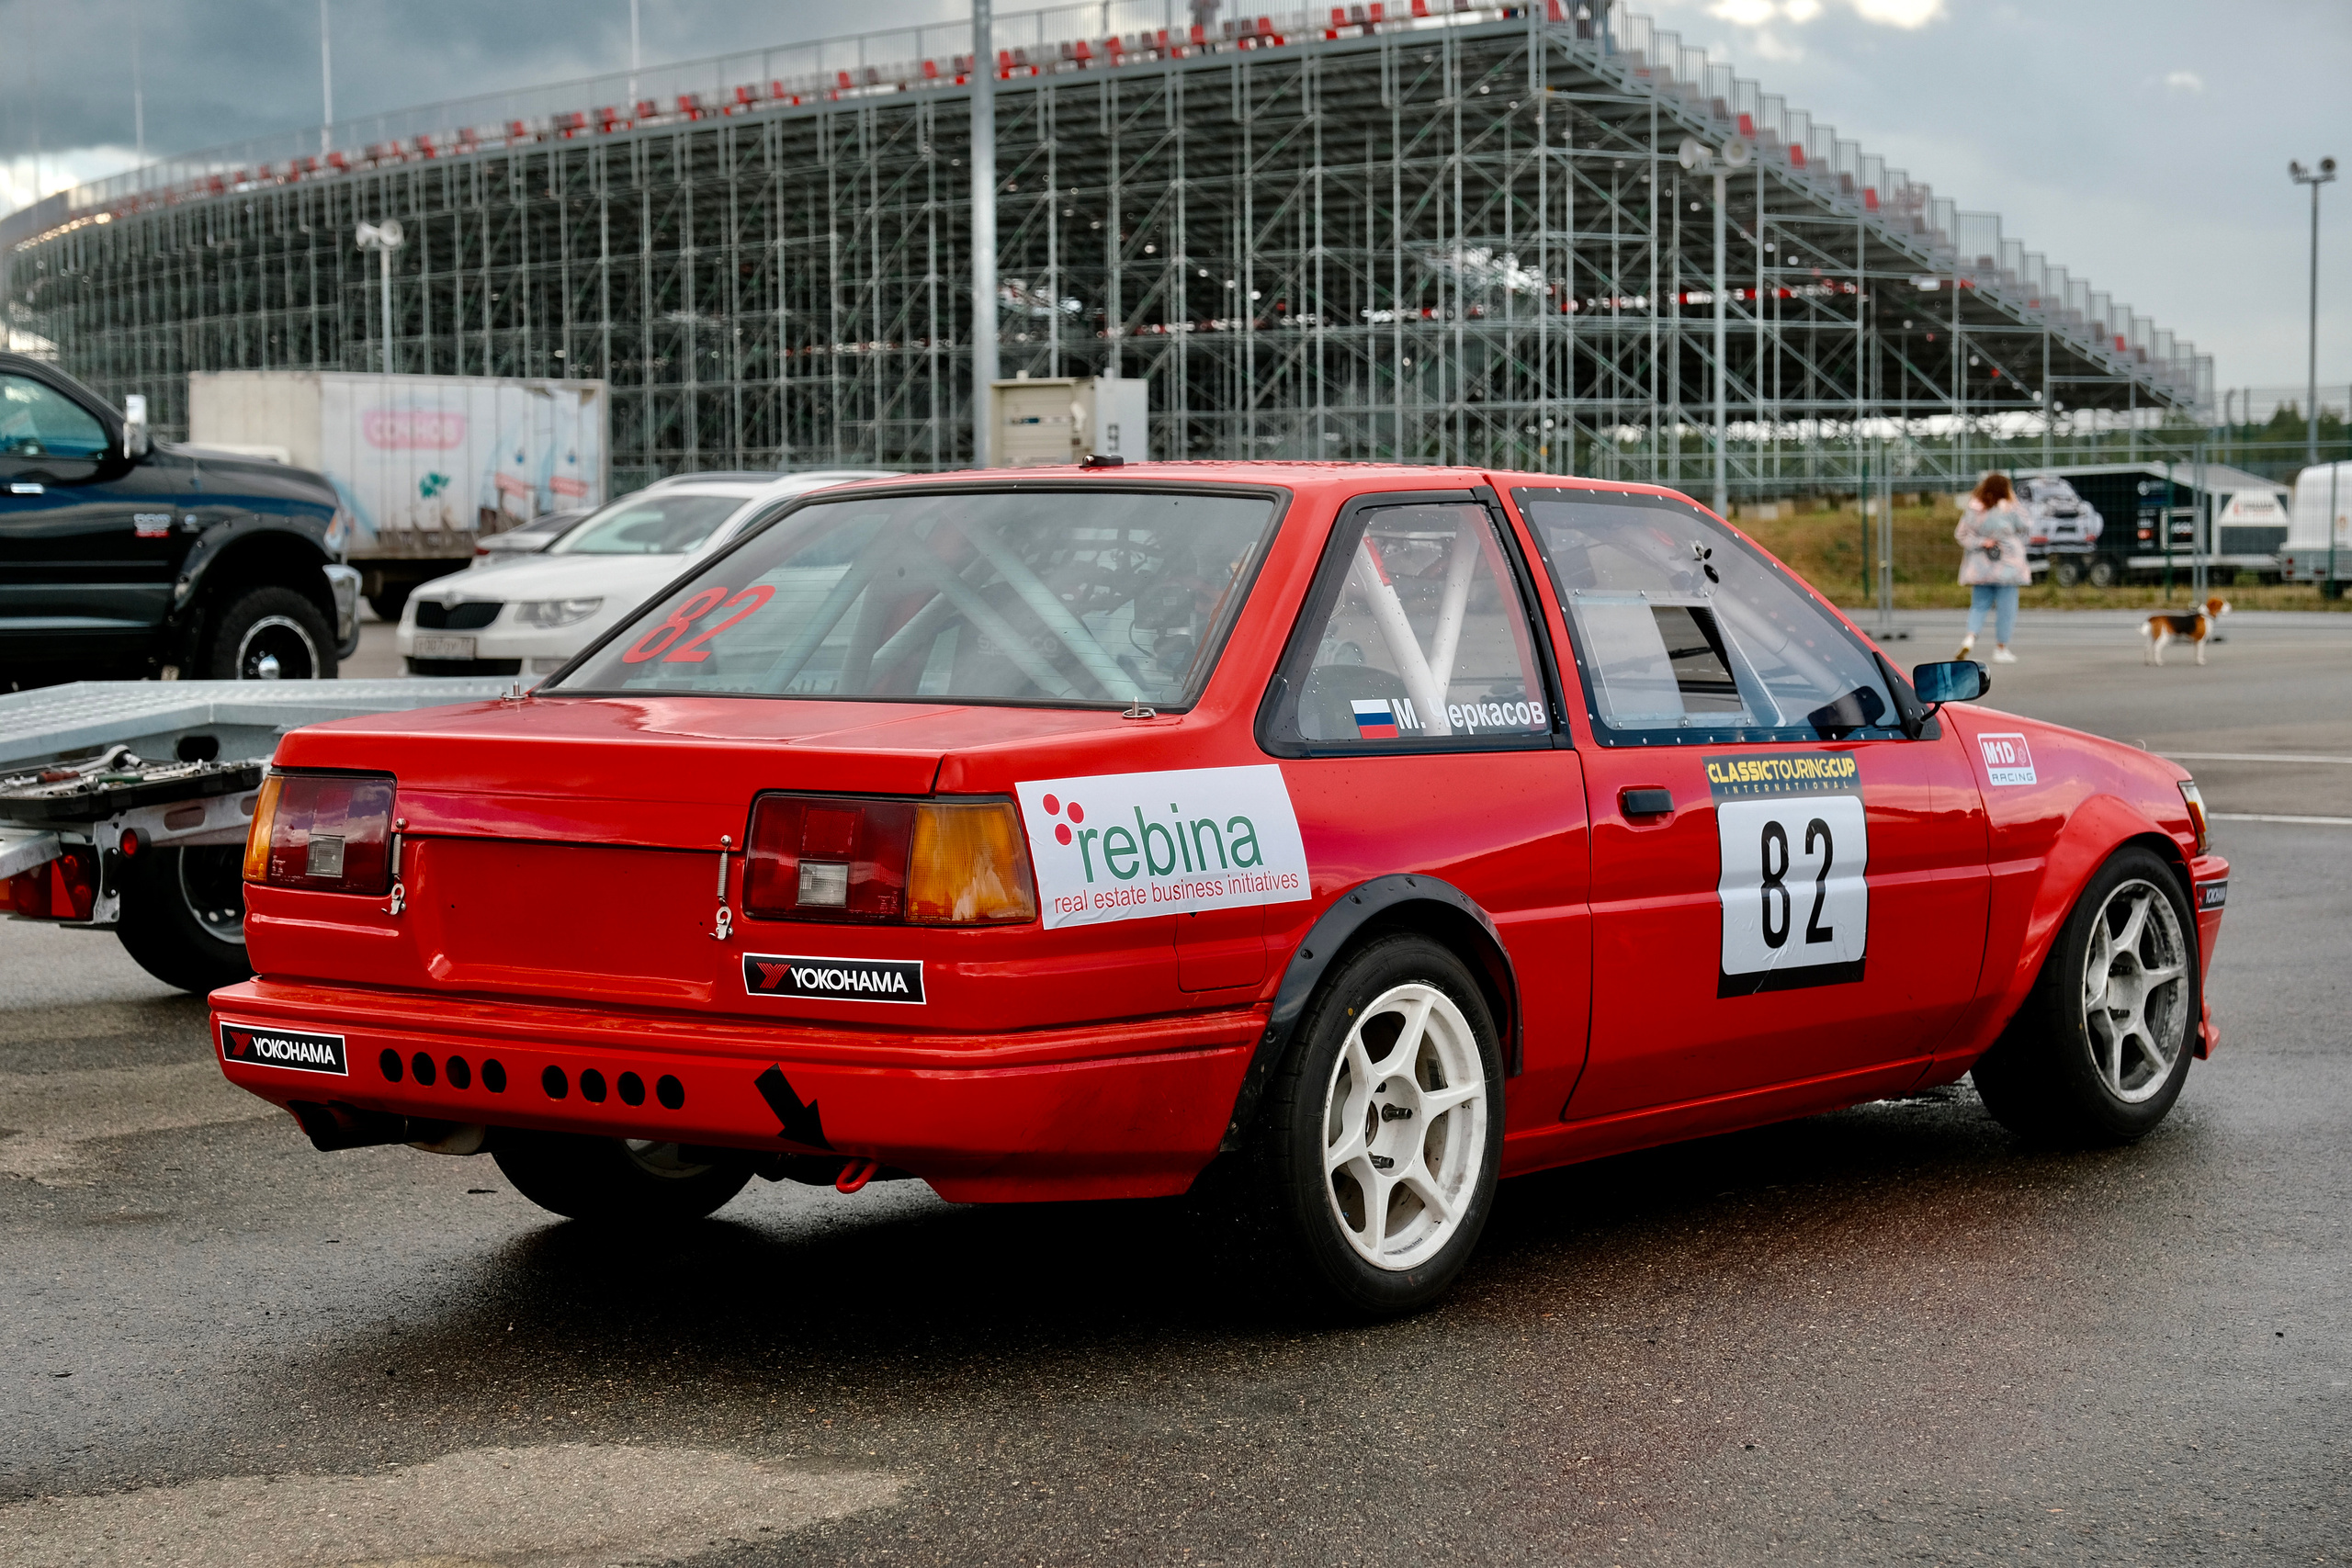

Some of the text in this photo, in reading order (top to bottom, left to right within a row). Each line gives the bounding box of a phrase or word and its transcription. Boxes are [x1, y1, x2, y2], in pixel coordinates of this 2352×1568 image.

[623, 585, 775, 664] 82
[1392, 699, 1426, 730] М.
[1983, 741, 2016, 764] M1D
[1724, 781, 1849, 795] INTERNATIONAL
[1992, 773, 2034, 782] RACING
[1077, 803, 1263, 884] rebina
[1054, 871, 1299, 914] real estate business initiatives
[1761, 818, 1834, 949] 82
[789, 968, 910, 994] YOKOHAMA
[252, 1036, 337, 1066] YOKOHAMA
